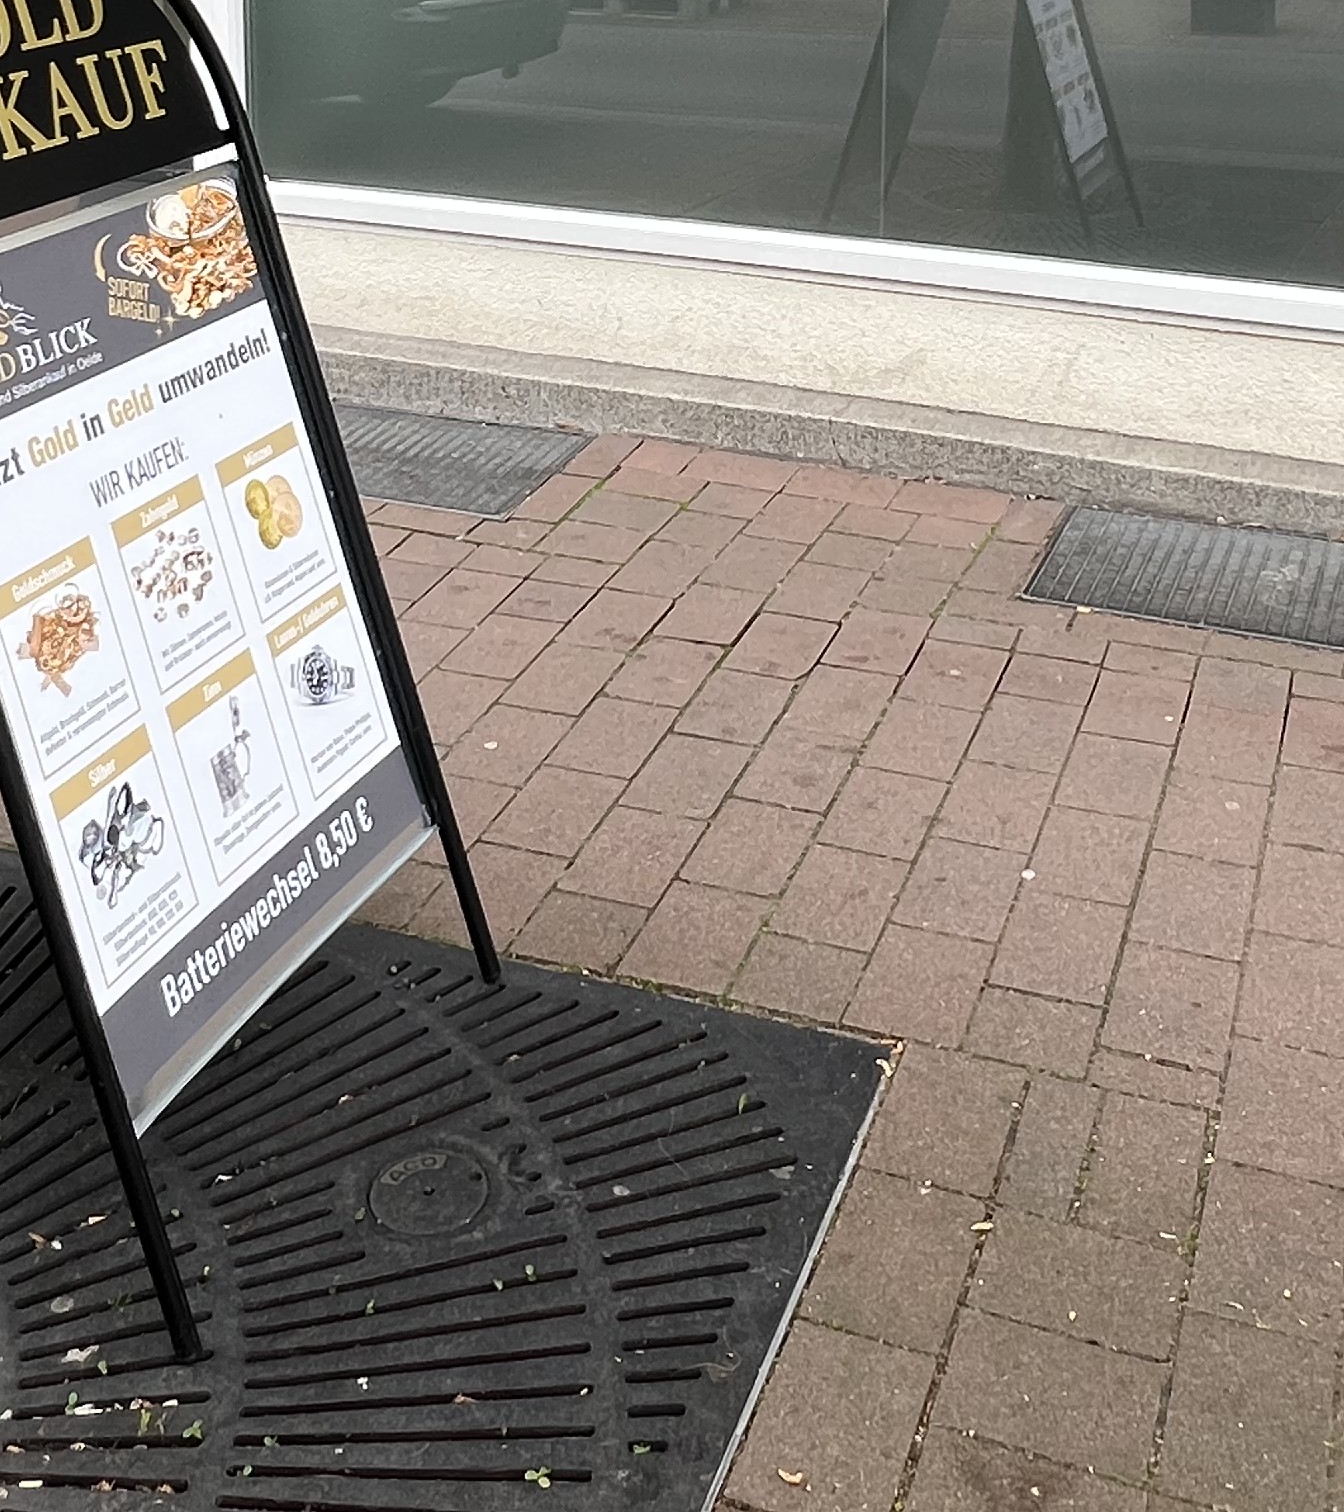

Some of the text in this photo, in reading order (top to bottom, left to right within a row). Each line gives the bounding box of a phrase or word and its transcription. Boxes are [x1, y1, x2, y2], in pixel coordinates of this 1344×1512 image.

[16, 317, 98, 374] BLICK
[27, 419, 79, 469] Gold
[80, 412, 105, 441] in
[107, 383, 154, 429] Geld
[158, 328, 271, 404] umwandeln!
[88, 436, 189, 508] WIR KAUFEN:
[160, 845, 319, 1017] Batteriewechsel
[314, 809, 358, 869] 8,50
[355, 796, 374, 833] €
